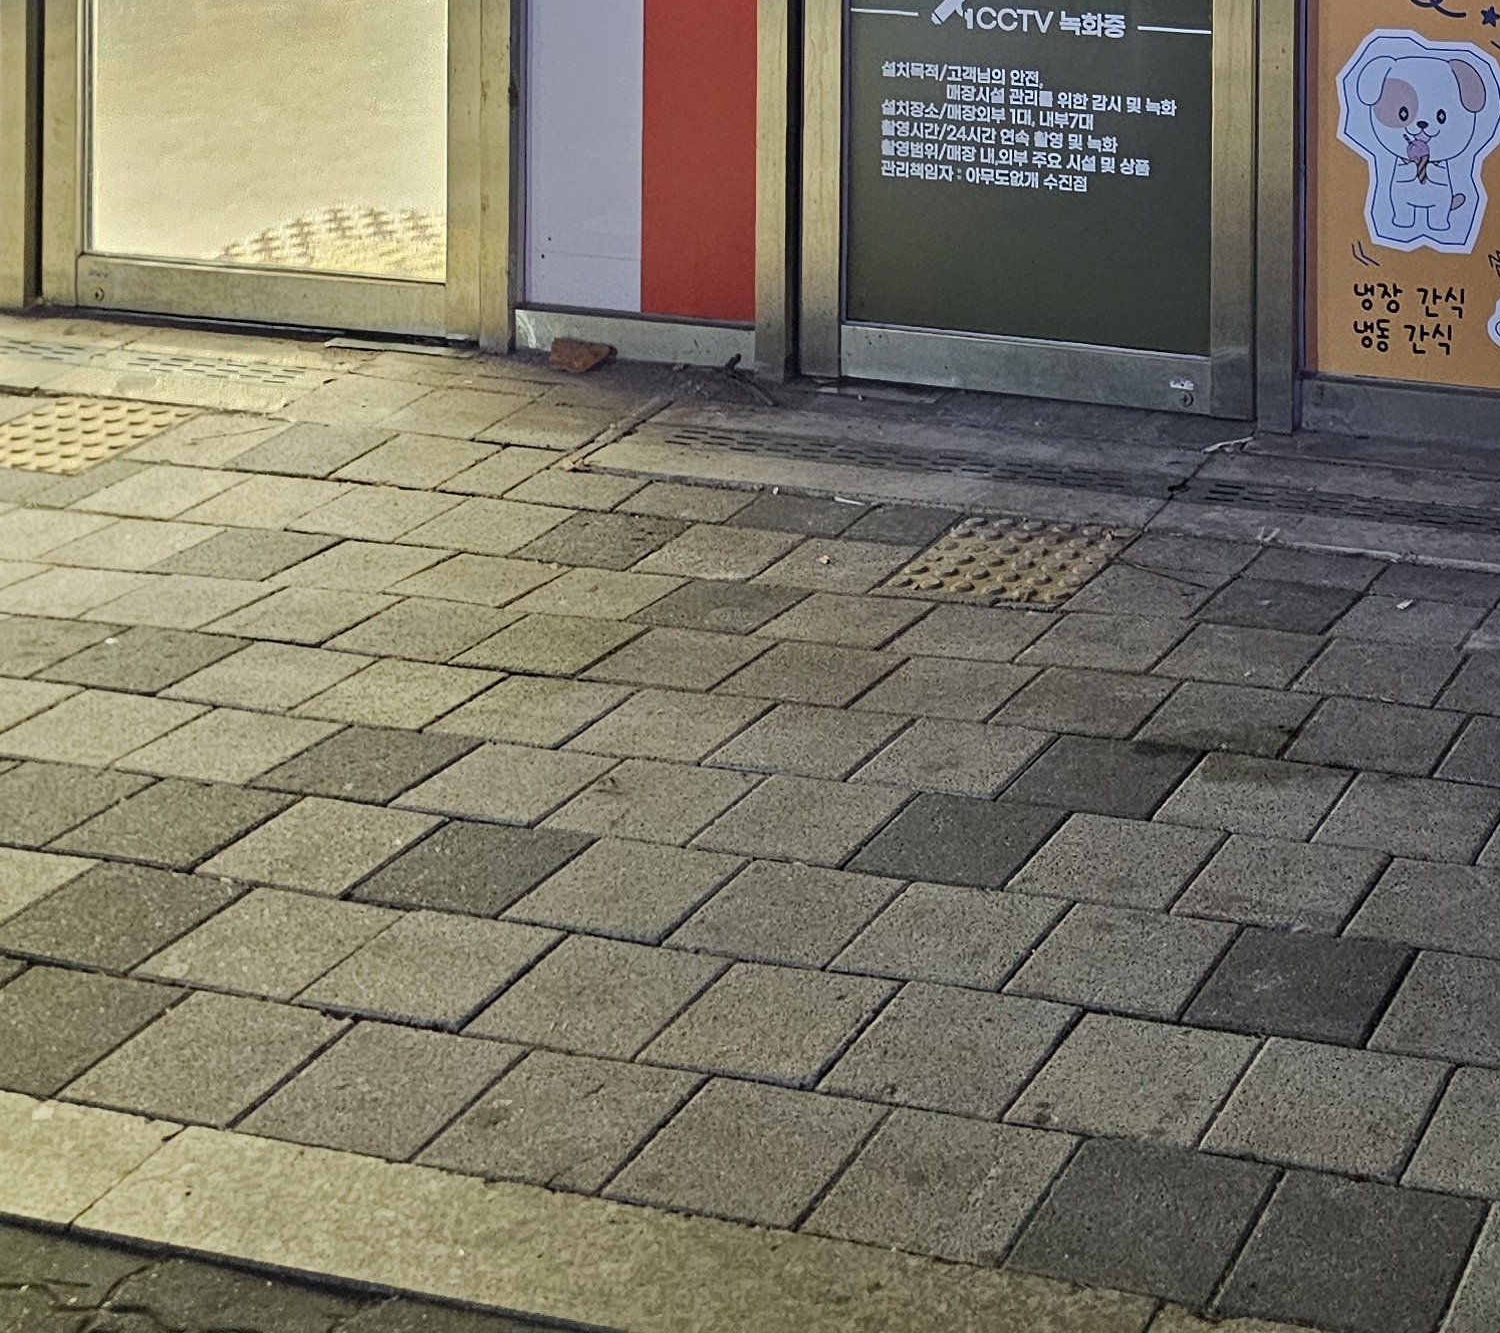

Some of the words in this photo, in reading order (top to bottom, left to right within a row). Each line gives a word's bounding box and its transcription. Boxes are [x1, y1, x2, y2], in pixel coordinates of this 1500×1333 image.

[977, 6, 1054, 33] CCTV
[1059, 10, 1126, 39] 녹화중
[882, 60, 1006, 85] 설치목적/고객님의
[881, 98, 1006, 124] 설치장소/매장외부
[1039, 111, 1094, 131] 내부7대
[946, 84, 1006, 104] 매장시설
[1009, 88, 1053, 108] 관리를
[1057, 92, 1089, 111] 위한
[1092, 94, 1122, 113] 감시
[1127, 97, 1142, 114] 및
[1145, 98, 1177, 117] 녹화
[881, 118, 997, 144] 촬영시간/24시간
[1000, 128, 1030, 147] 연속
[1034, 130, 1063, 150] 촬영
[1068, 133, 1083, 151] 및
[1087, 135, 1118, 154] 녹화
[881, 138, 977, 163] 촬영범위/매장
[1032, 150, 1063, 170] 주요
[1066, 153, 1097, 173] 시설
[1100, 156, 1116, 174] 및
[1120, 158, 1150, 177] 상품
[881, 160, 954, 182] 관리책임자
[966, 167, 1039, 189] 아무도없개
[1043, 174, 1088, 193] 수진점
[1353, 281, 1404, 315] 냉장
[1416, 286, 1467, 319] 간식
[1353, 317, 1394, 354] 냉동
[1404, 322, 1455, 356] 간식
